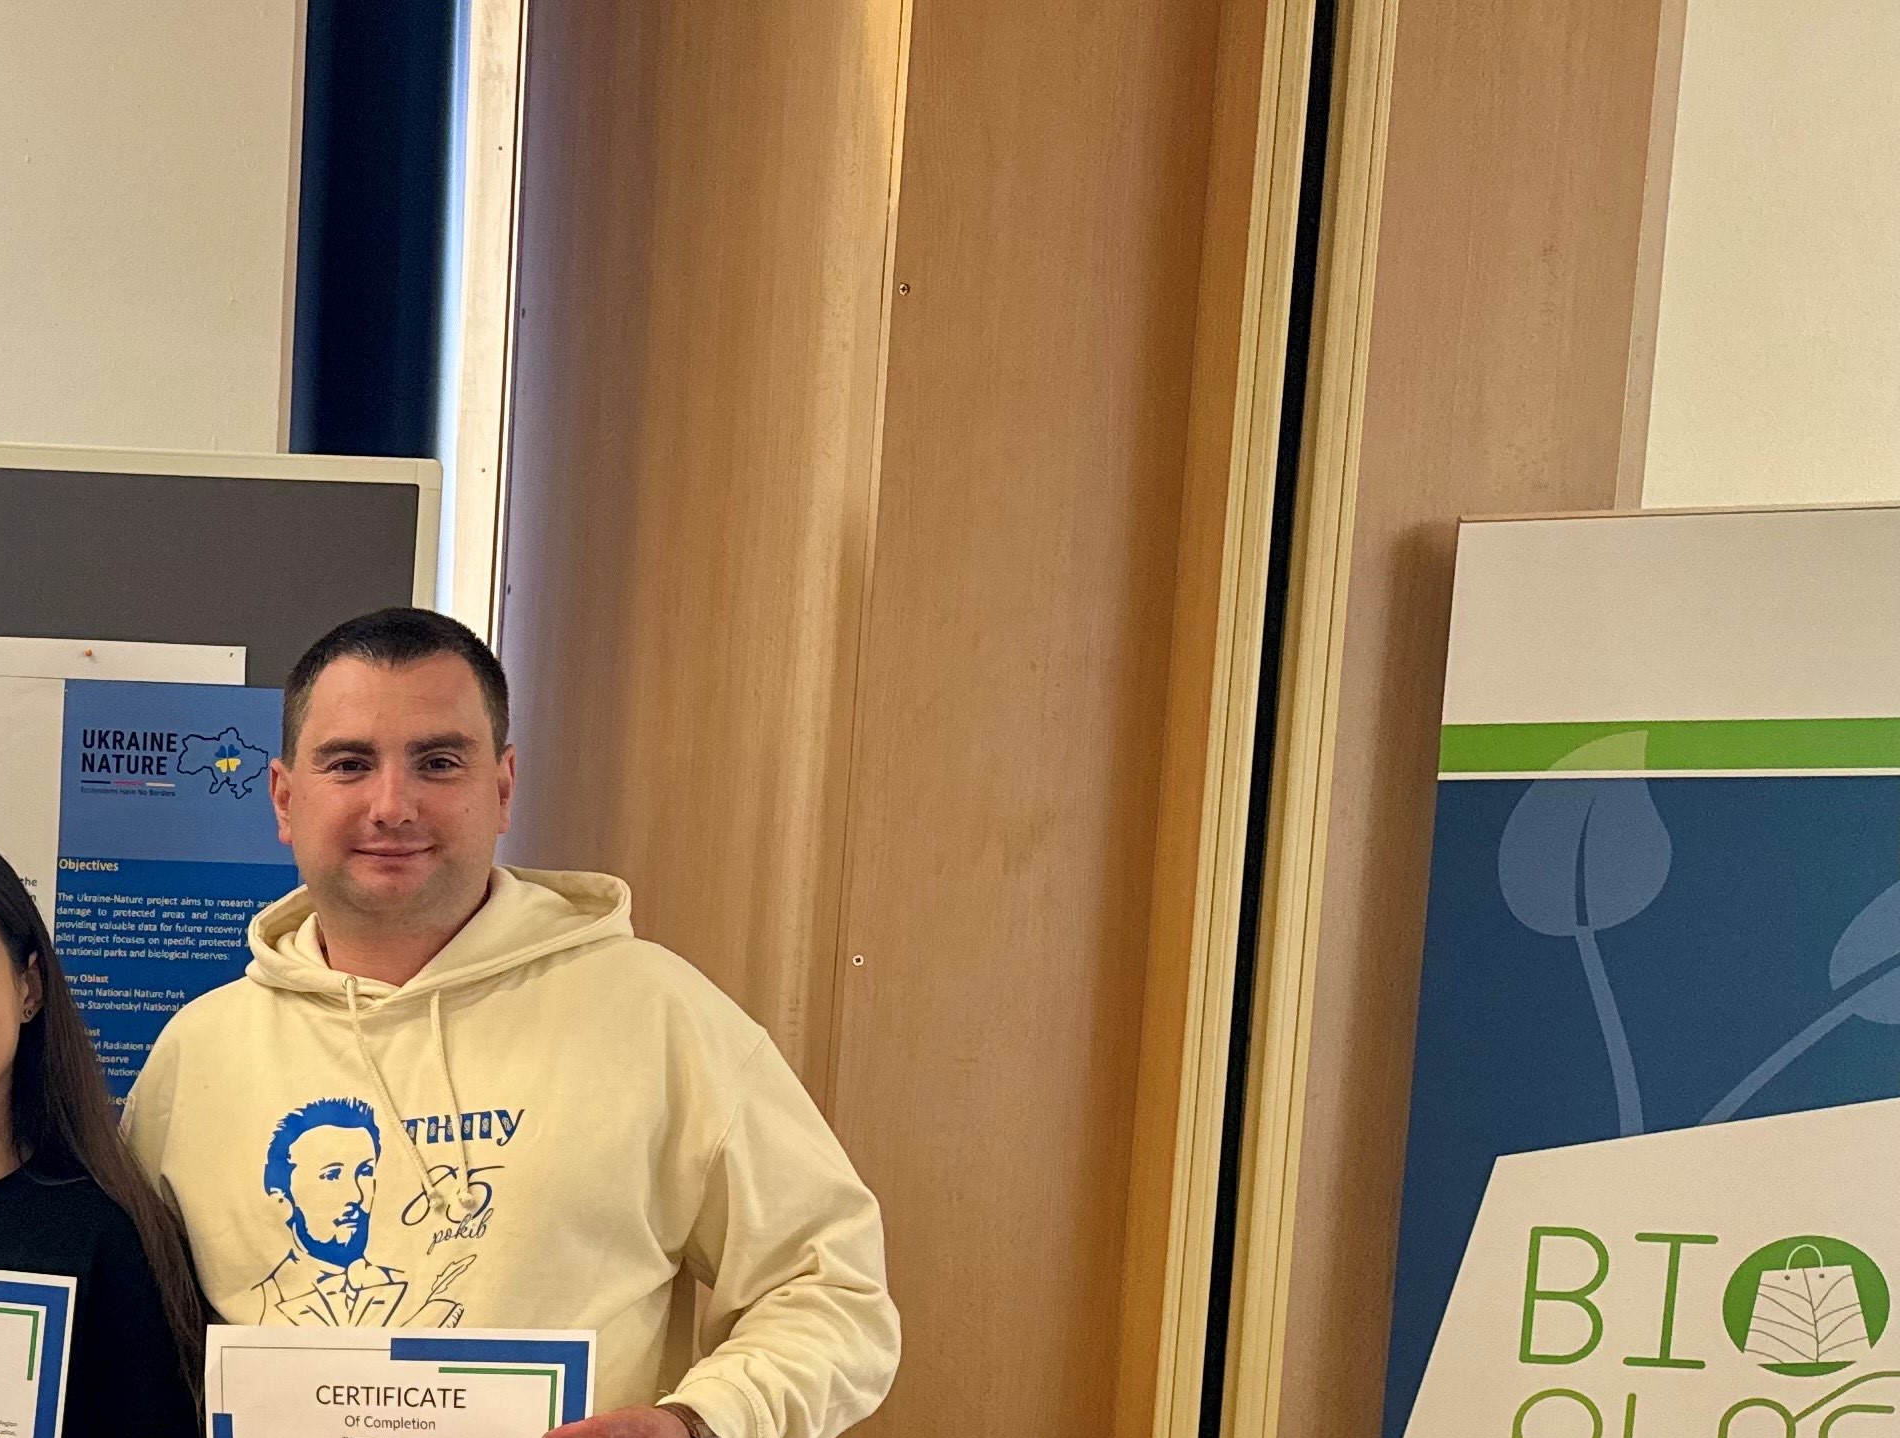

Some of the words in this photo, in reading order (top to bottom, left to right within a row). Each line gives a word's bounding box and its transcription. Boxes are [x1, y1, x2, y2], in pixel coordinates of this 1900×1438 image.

[82, 729, 178, 752] UKRAINE
[82, 752, 167, 775] NATURE
[58, 858, 119, 872] Objectives
[57, 892, 74, 902] The
[77, 892, 143, 905] Ukraine-Nature
[147, 896, 177, 908] project
[204, 897, 215, 907] to
[1519, 1225, 1891, 1377] BIO
[316, 1384, 467, 1409] CERTIFICATE
[344, 1415, 361, 1427] Of
[363, 1416, 436, 1431] Completion
